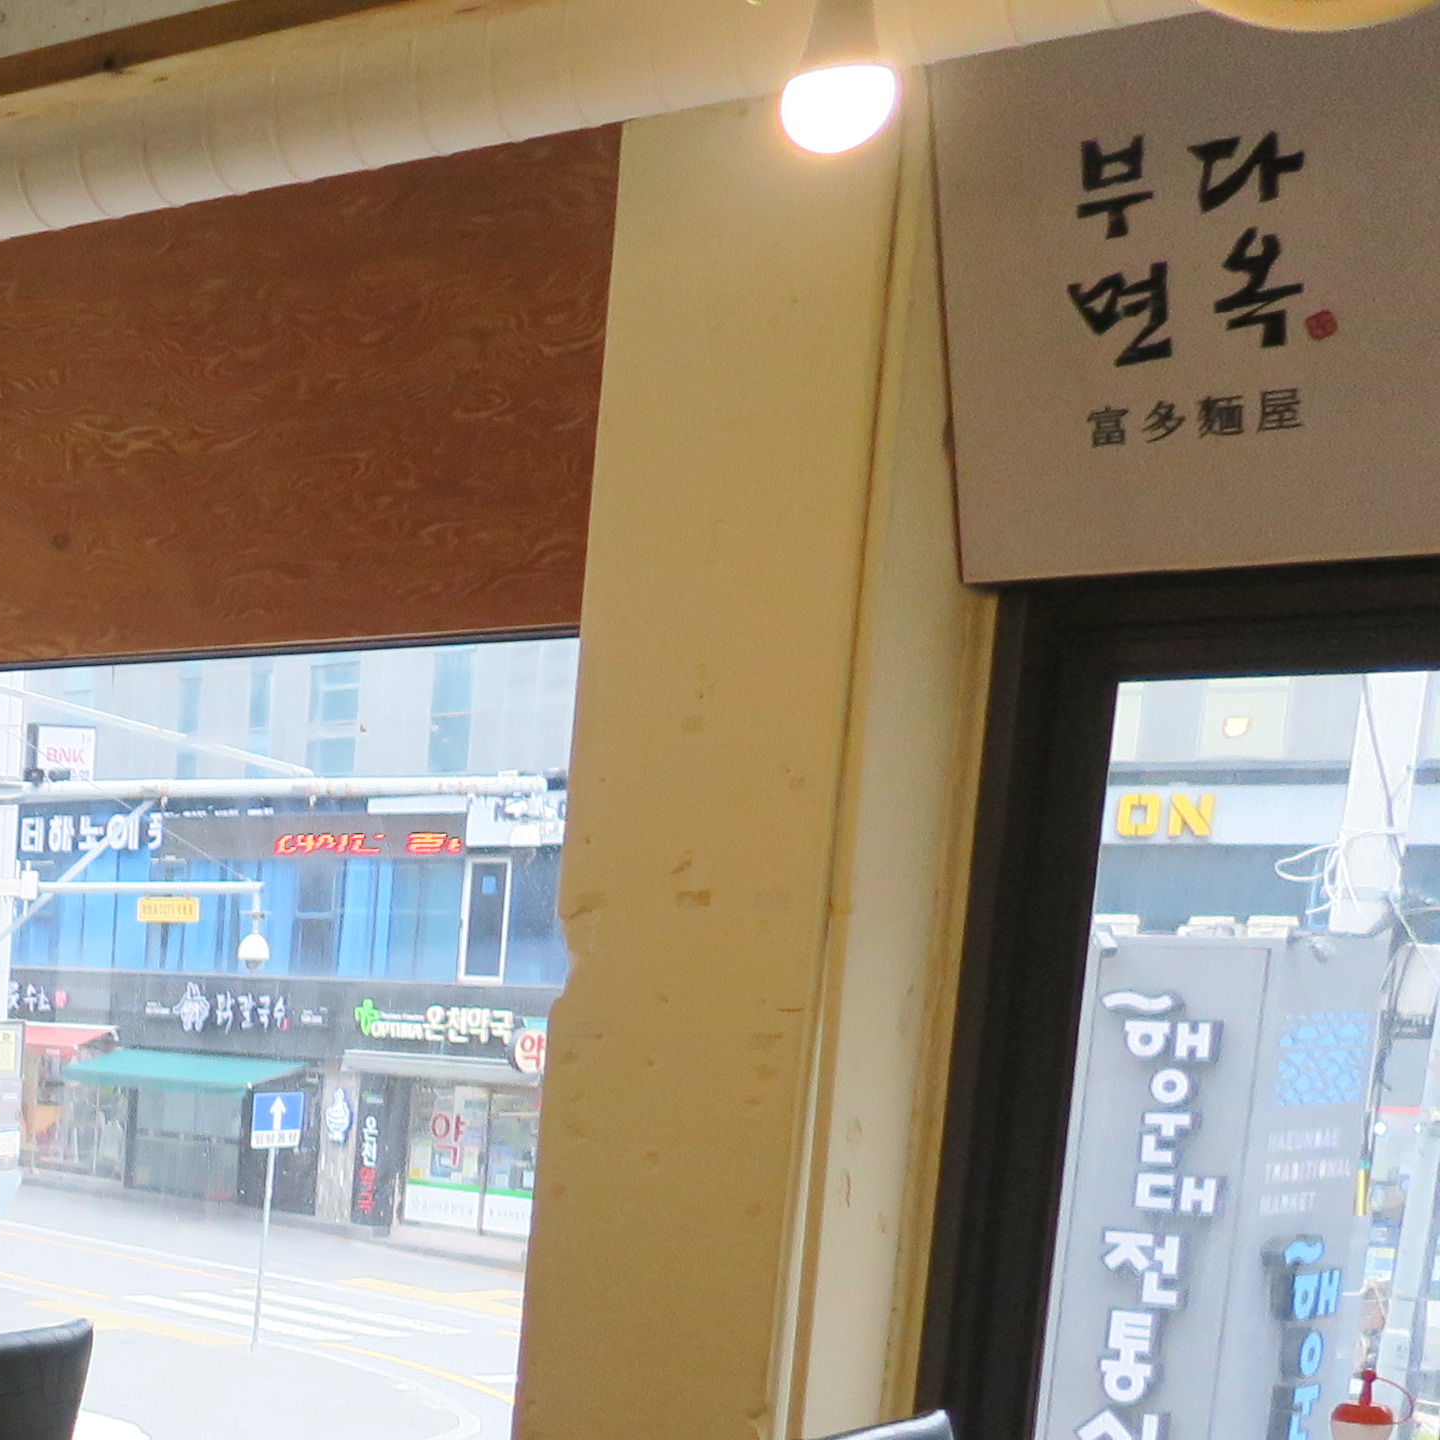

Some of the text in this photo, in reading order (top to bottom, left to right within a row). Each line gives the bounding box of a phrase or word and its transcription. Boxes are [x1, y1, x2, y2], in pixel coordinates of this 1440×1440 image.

[1086, 387, 1304, 448] 富多麵屋
[46, 746, 86, 764] BNK
[370, 1004, 515, 1046] OPTIMA 온천약국
[430, 1112, 466, 1167] 약
[1258, 1190, 1319, 1217] MARKET
